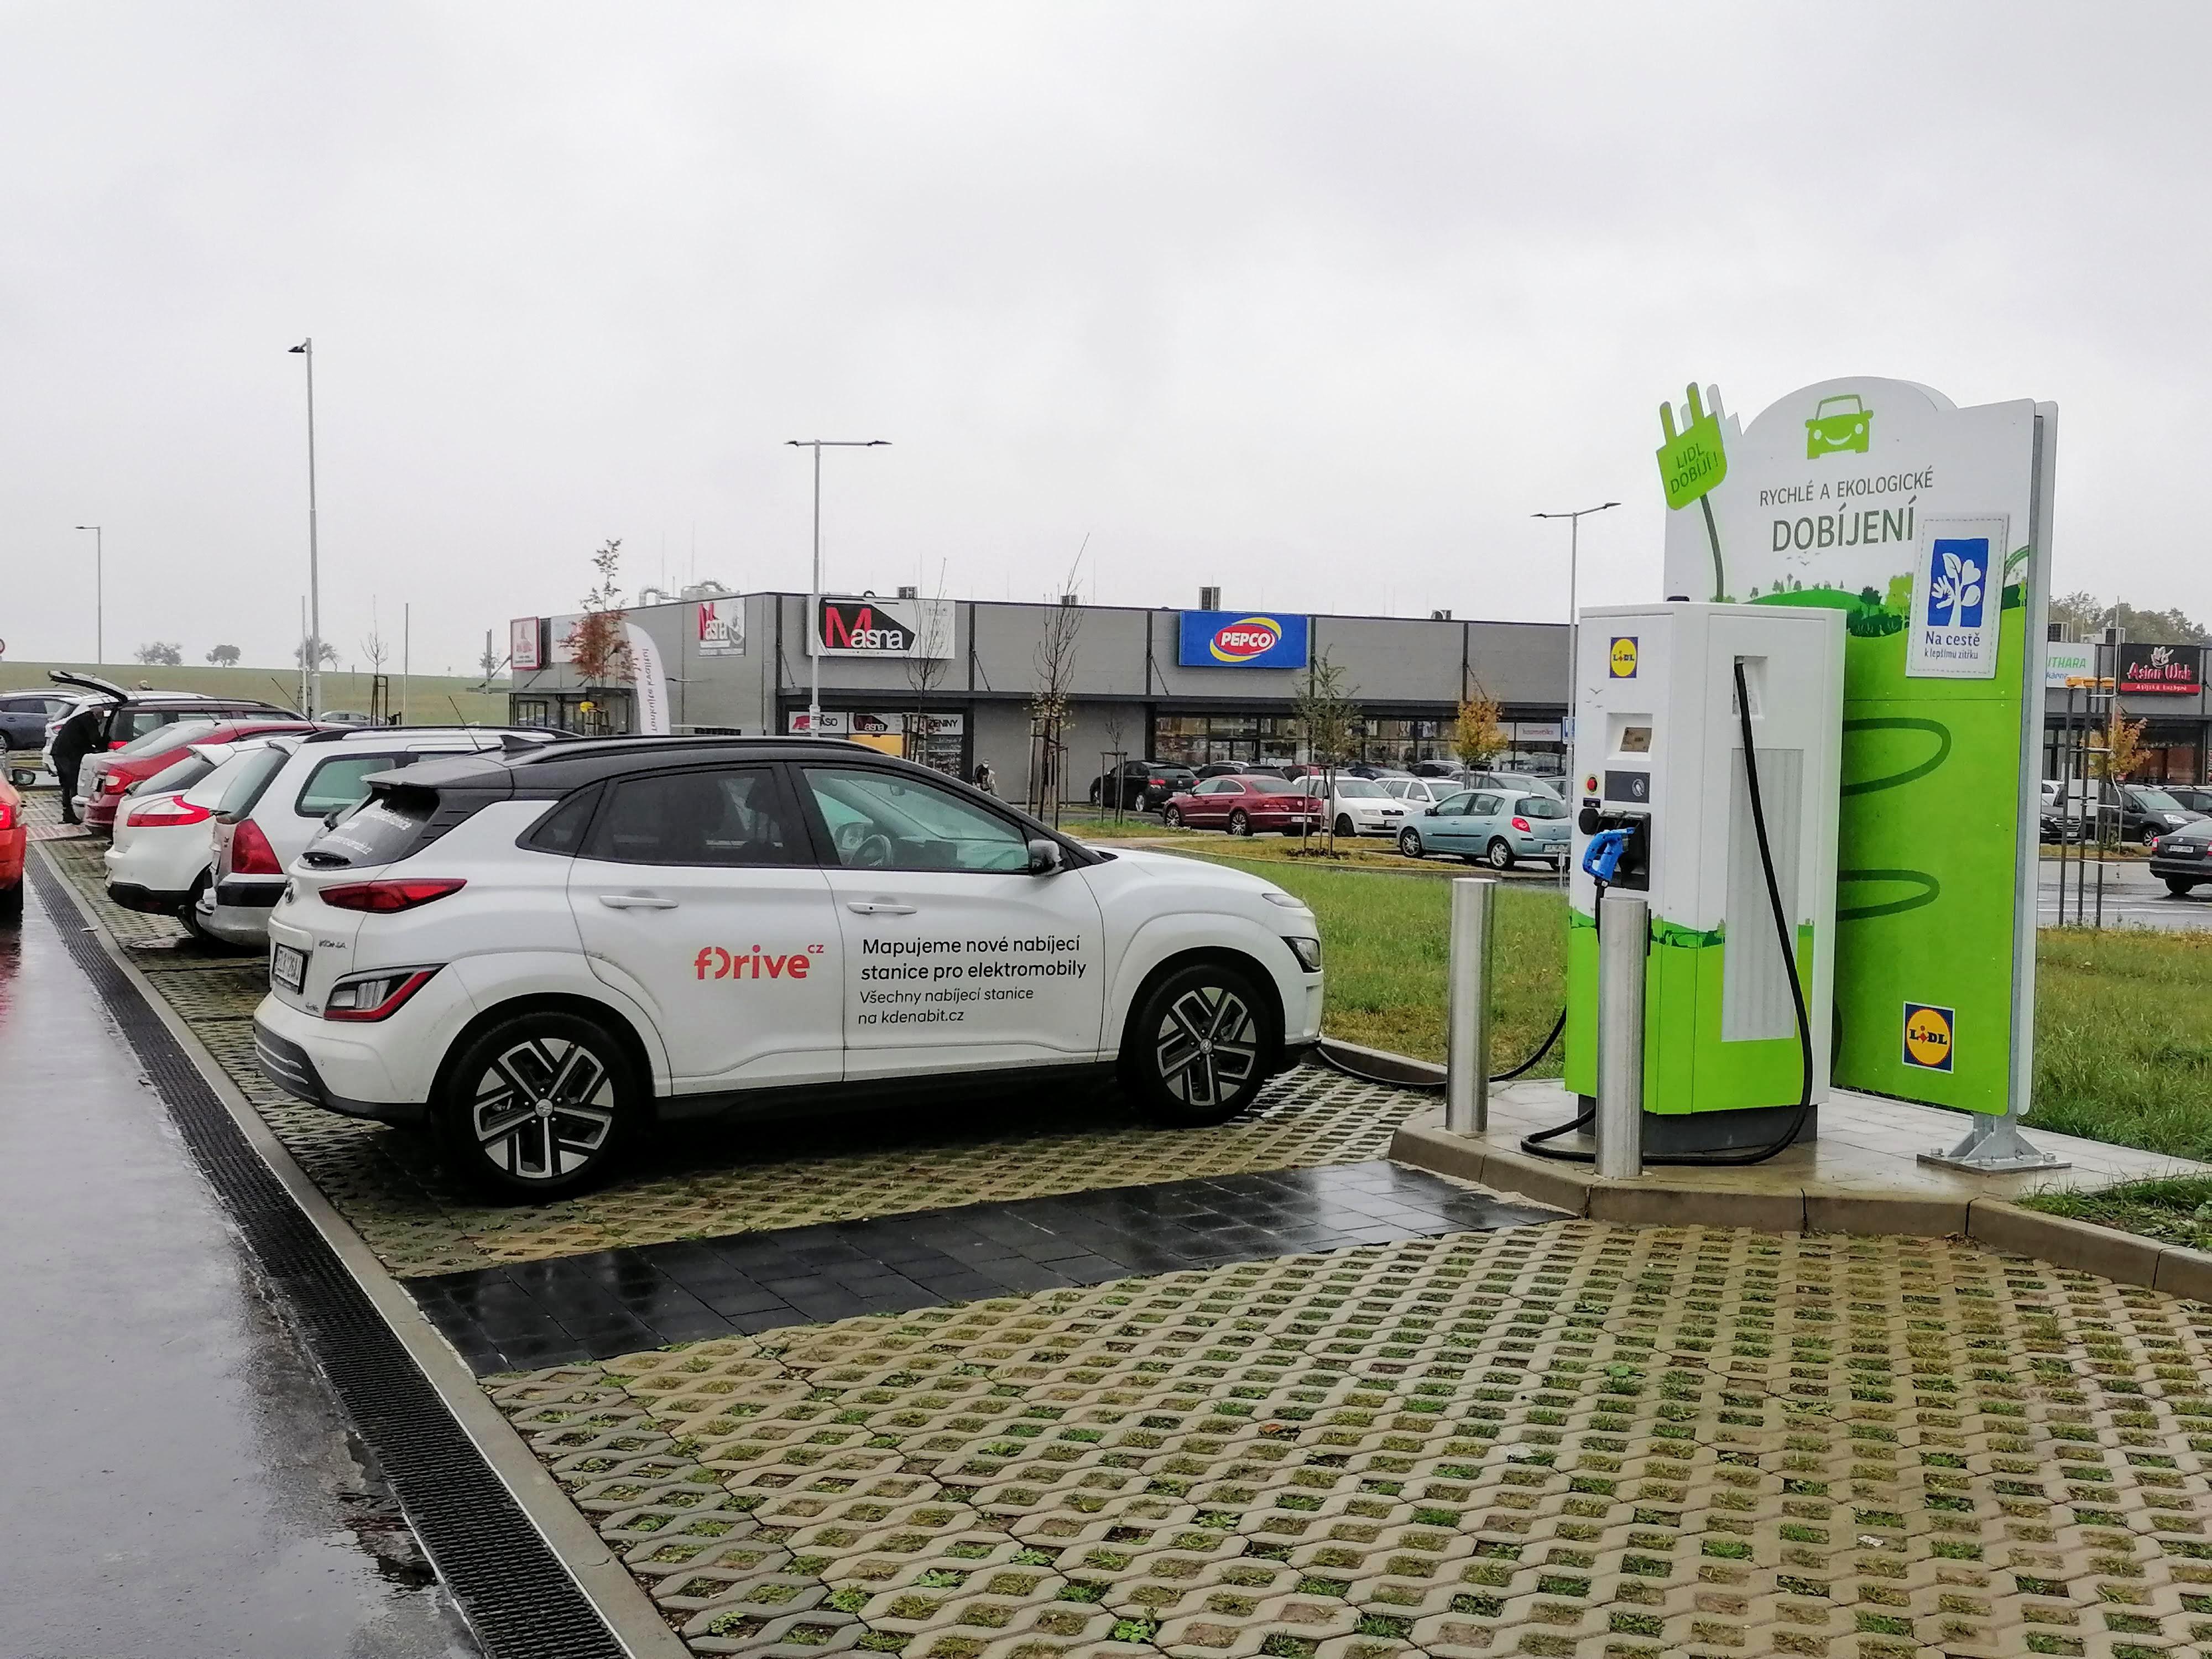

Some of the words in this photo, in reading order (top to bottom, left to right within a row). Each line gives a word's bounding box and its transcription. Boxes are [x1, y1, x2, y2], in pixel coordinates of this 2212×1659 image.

[1676, 443, 1704, 469] LIDL
[1760, 479, 1814, 507] RYCHLÉ
[1820, 483, 1830, 499] A
[1837, 465, 1933, 497] EKOLOGICKÉ
[1772, 494, 1917, 552] DOBÍJENÍ
[826, 607, 903, 649] Masna
[1926, 630, 1942, 645] Na
[1946, 633, 1980, 646] cestě
[1220, 632, 1271, 648] PEPCO
[1924, 648, 1928, 658] k
[1930, 648, 1957, 660] lepšímu
[1958, 649, 1978, 659] zítřku
[820, 718, 837, 726] ASO
[862, 937, 961, 957] Mapujeme
[966, 936, 1008, 952] nové
[1013, 935, 1081, 954] nabíjecí
[861, 963, 928, 980] stanice
[933, 966, 963, 982] pro
[968, 960, 1087, 978] elektromobily
[860, 989, 922, 1005] Všechny
[925, 987, 981, 1004] nabíjecí
[984, 987, 1034, 1000] stanice
[858, 1014, 877, 1024] na
[881, 1010, 964, 1024] kdenabit.cz
